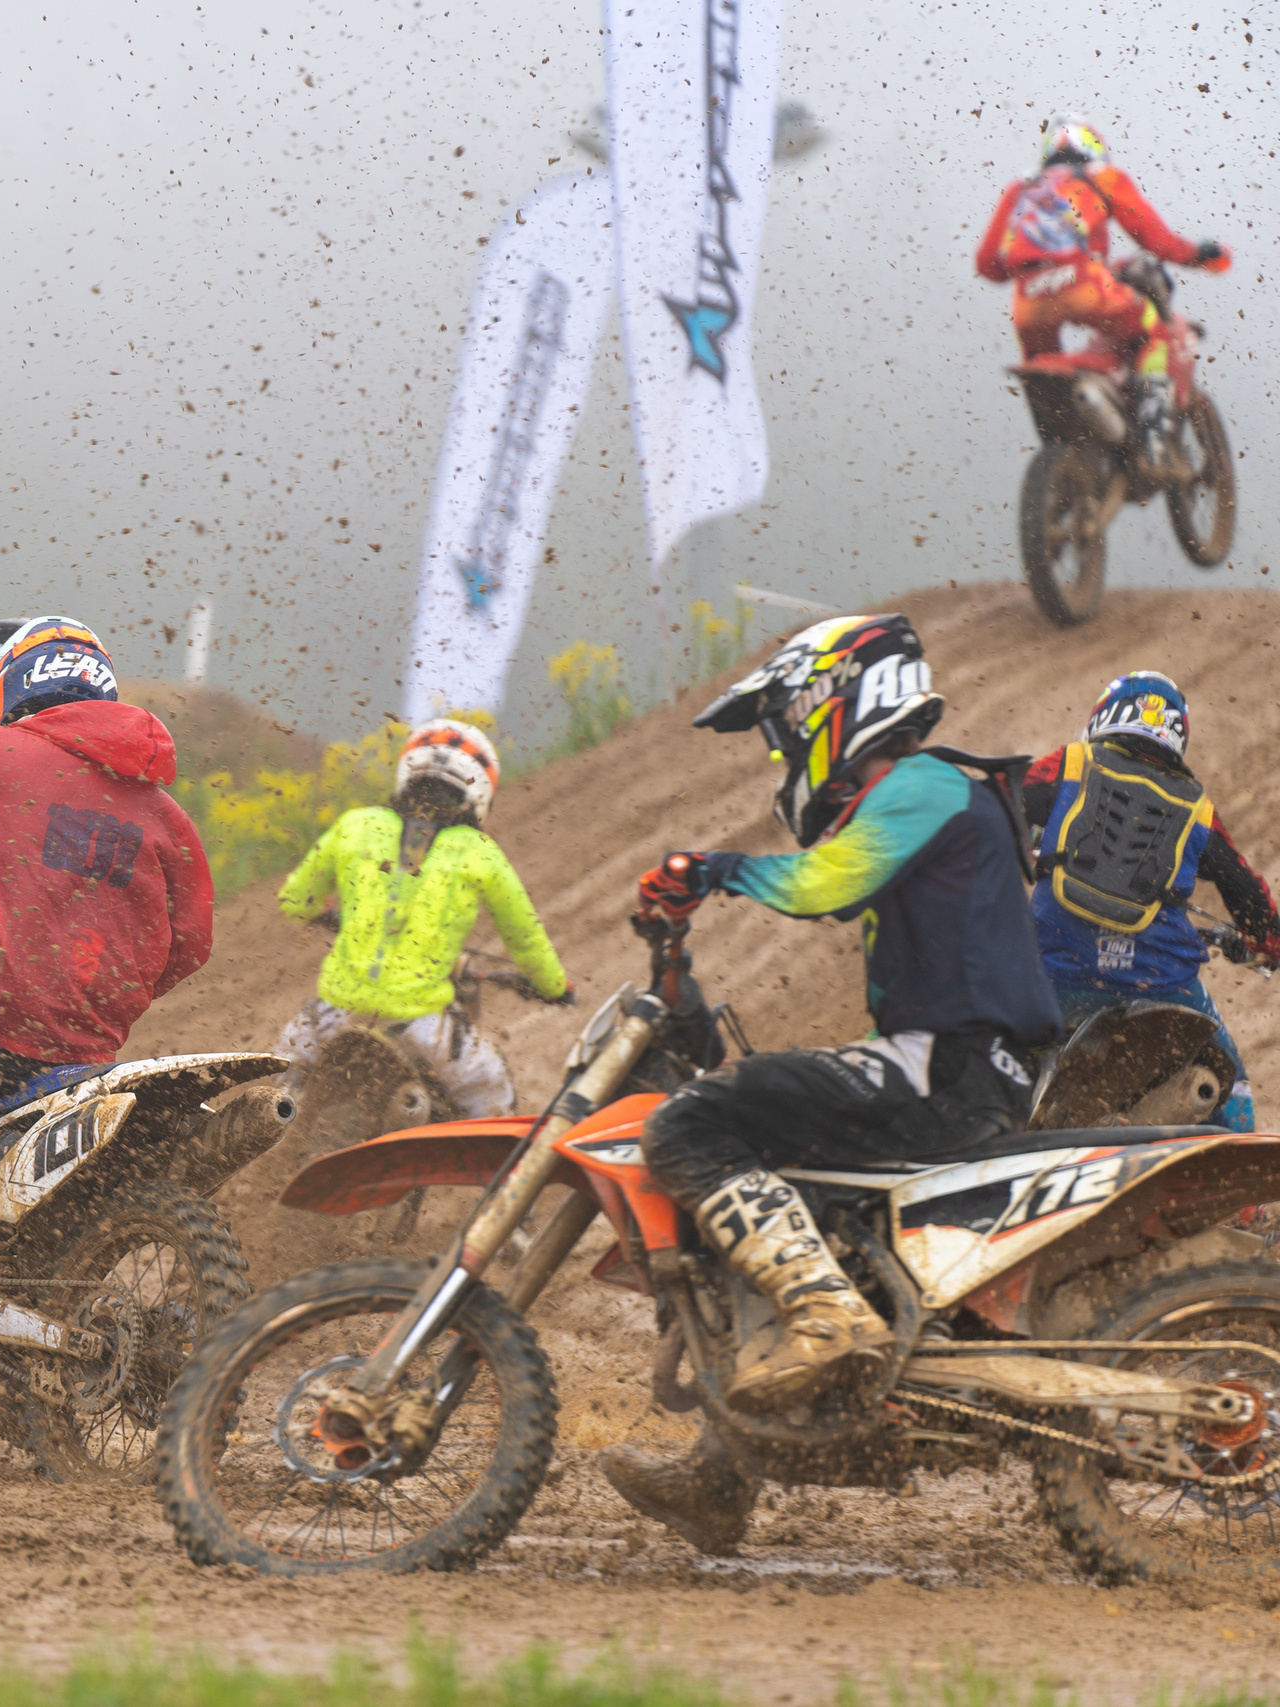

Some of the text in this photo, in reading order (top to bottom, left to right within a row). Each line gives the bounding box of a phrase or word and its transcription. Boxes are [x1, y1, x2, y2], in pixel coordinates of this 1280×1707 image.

[42, 803, 143, 889] 101
[1106, 940, 1129, 954] 100
[1005, 1157, 1124, 1229] 172
